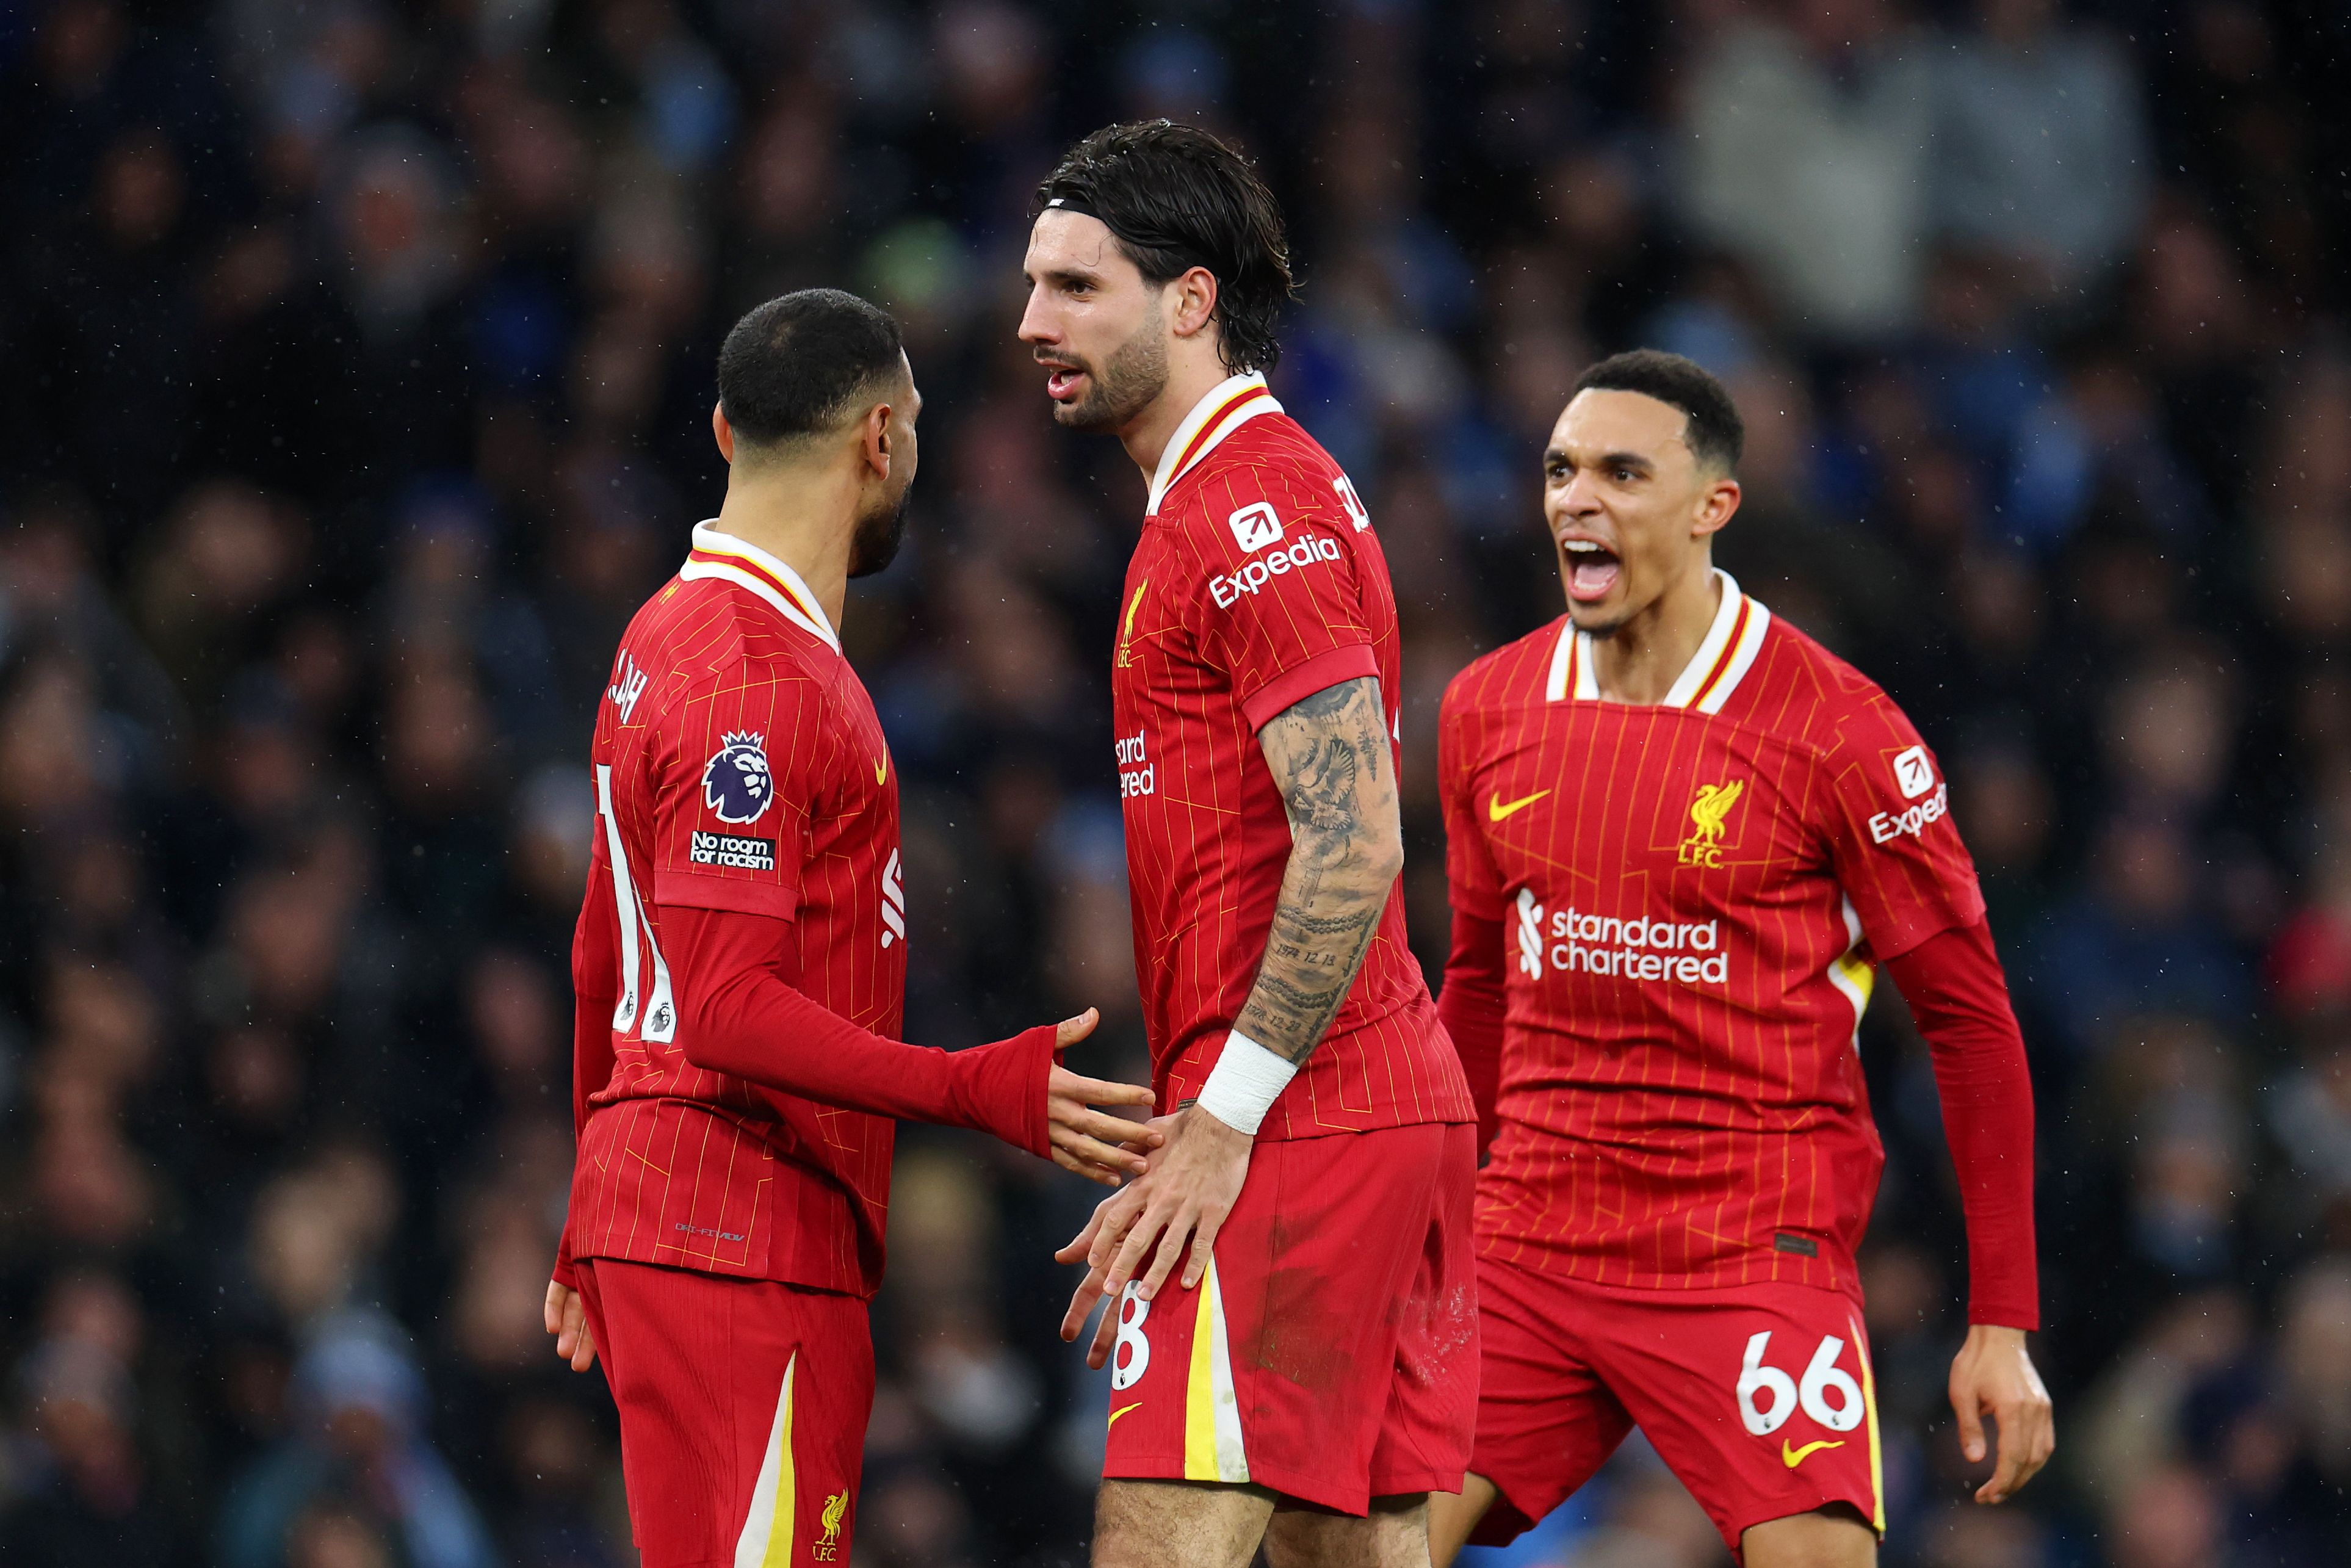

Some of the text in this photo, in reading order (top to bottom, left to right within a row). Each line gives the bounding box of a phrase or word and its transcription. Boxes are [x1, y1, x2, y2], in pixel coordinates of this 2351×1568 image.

[1209, 533, 1341, 609] Expedia
[1868, 782, 1947, 845] Exped
[692, 831, 768, 855] No room
[717, 851, 774, 871] racism
[1551, 906, 1717, 951] standard
[1550, 940, 1729, 984] chartered
[1111, 1279, 1151, 1391] 8
[1736, 1329, 1865, 1436] 66
